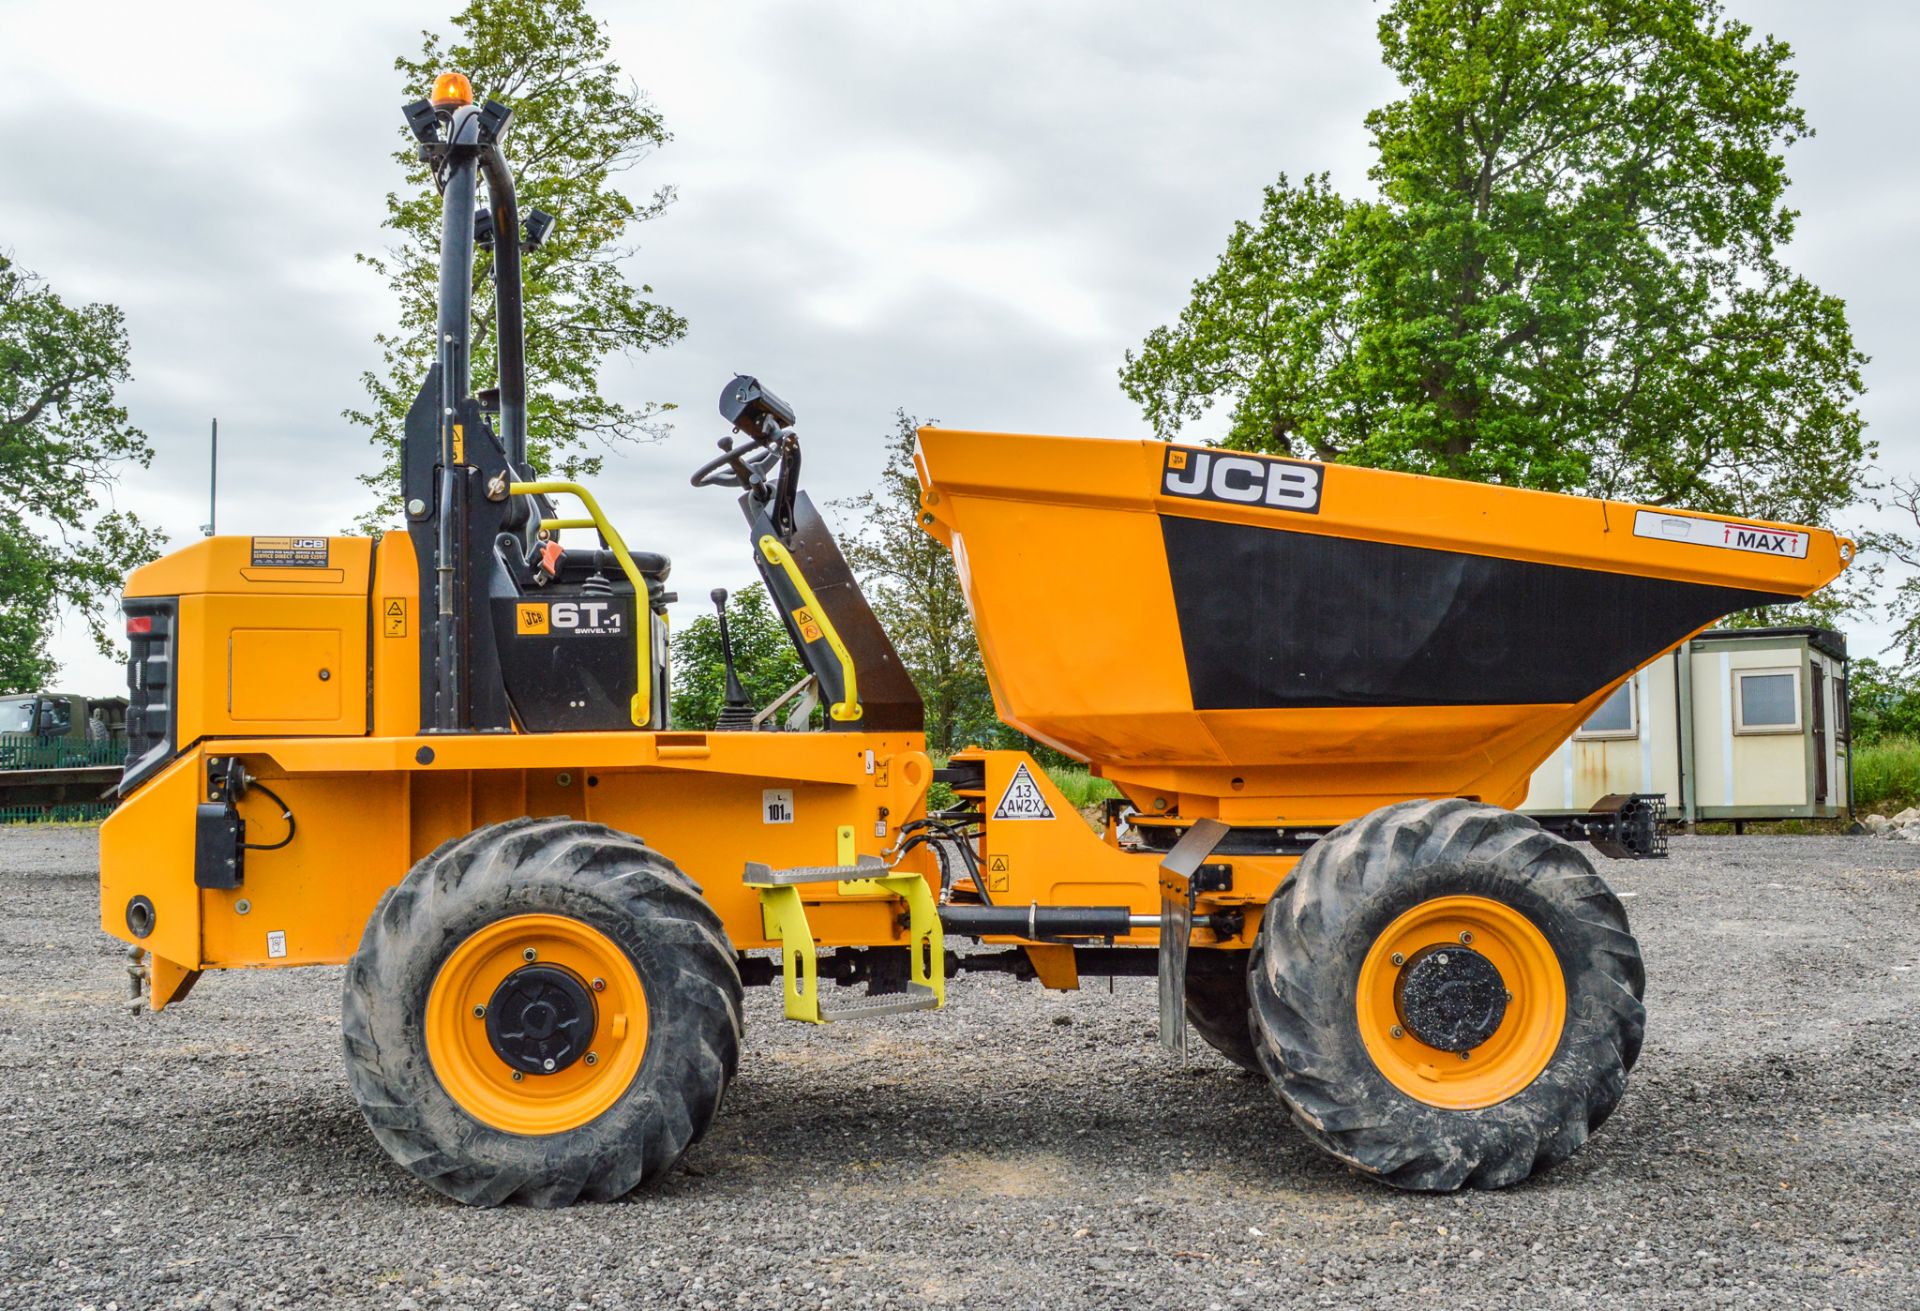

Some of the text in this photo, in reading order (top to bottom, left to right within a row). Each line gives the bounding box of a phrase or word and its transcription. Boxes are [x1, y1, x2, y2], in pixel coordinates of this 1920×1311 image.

[1166, 454, 1319, 509] JCB
[293, 539, 324, 548] JCB
[1736, 531, 1786, 552] MAX
[525, 611, 543, 626] JCB
[1015, 785, 1032, 798] 13
[768, 804, 784, 820] 101
[1007, 799, 1041, 813] AW2X
